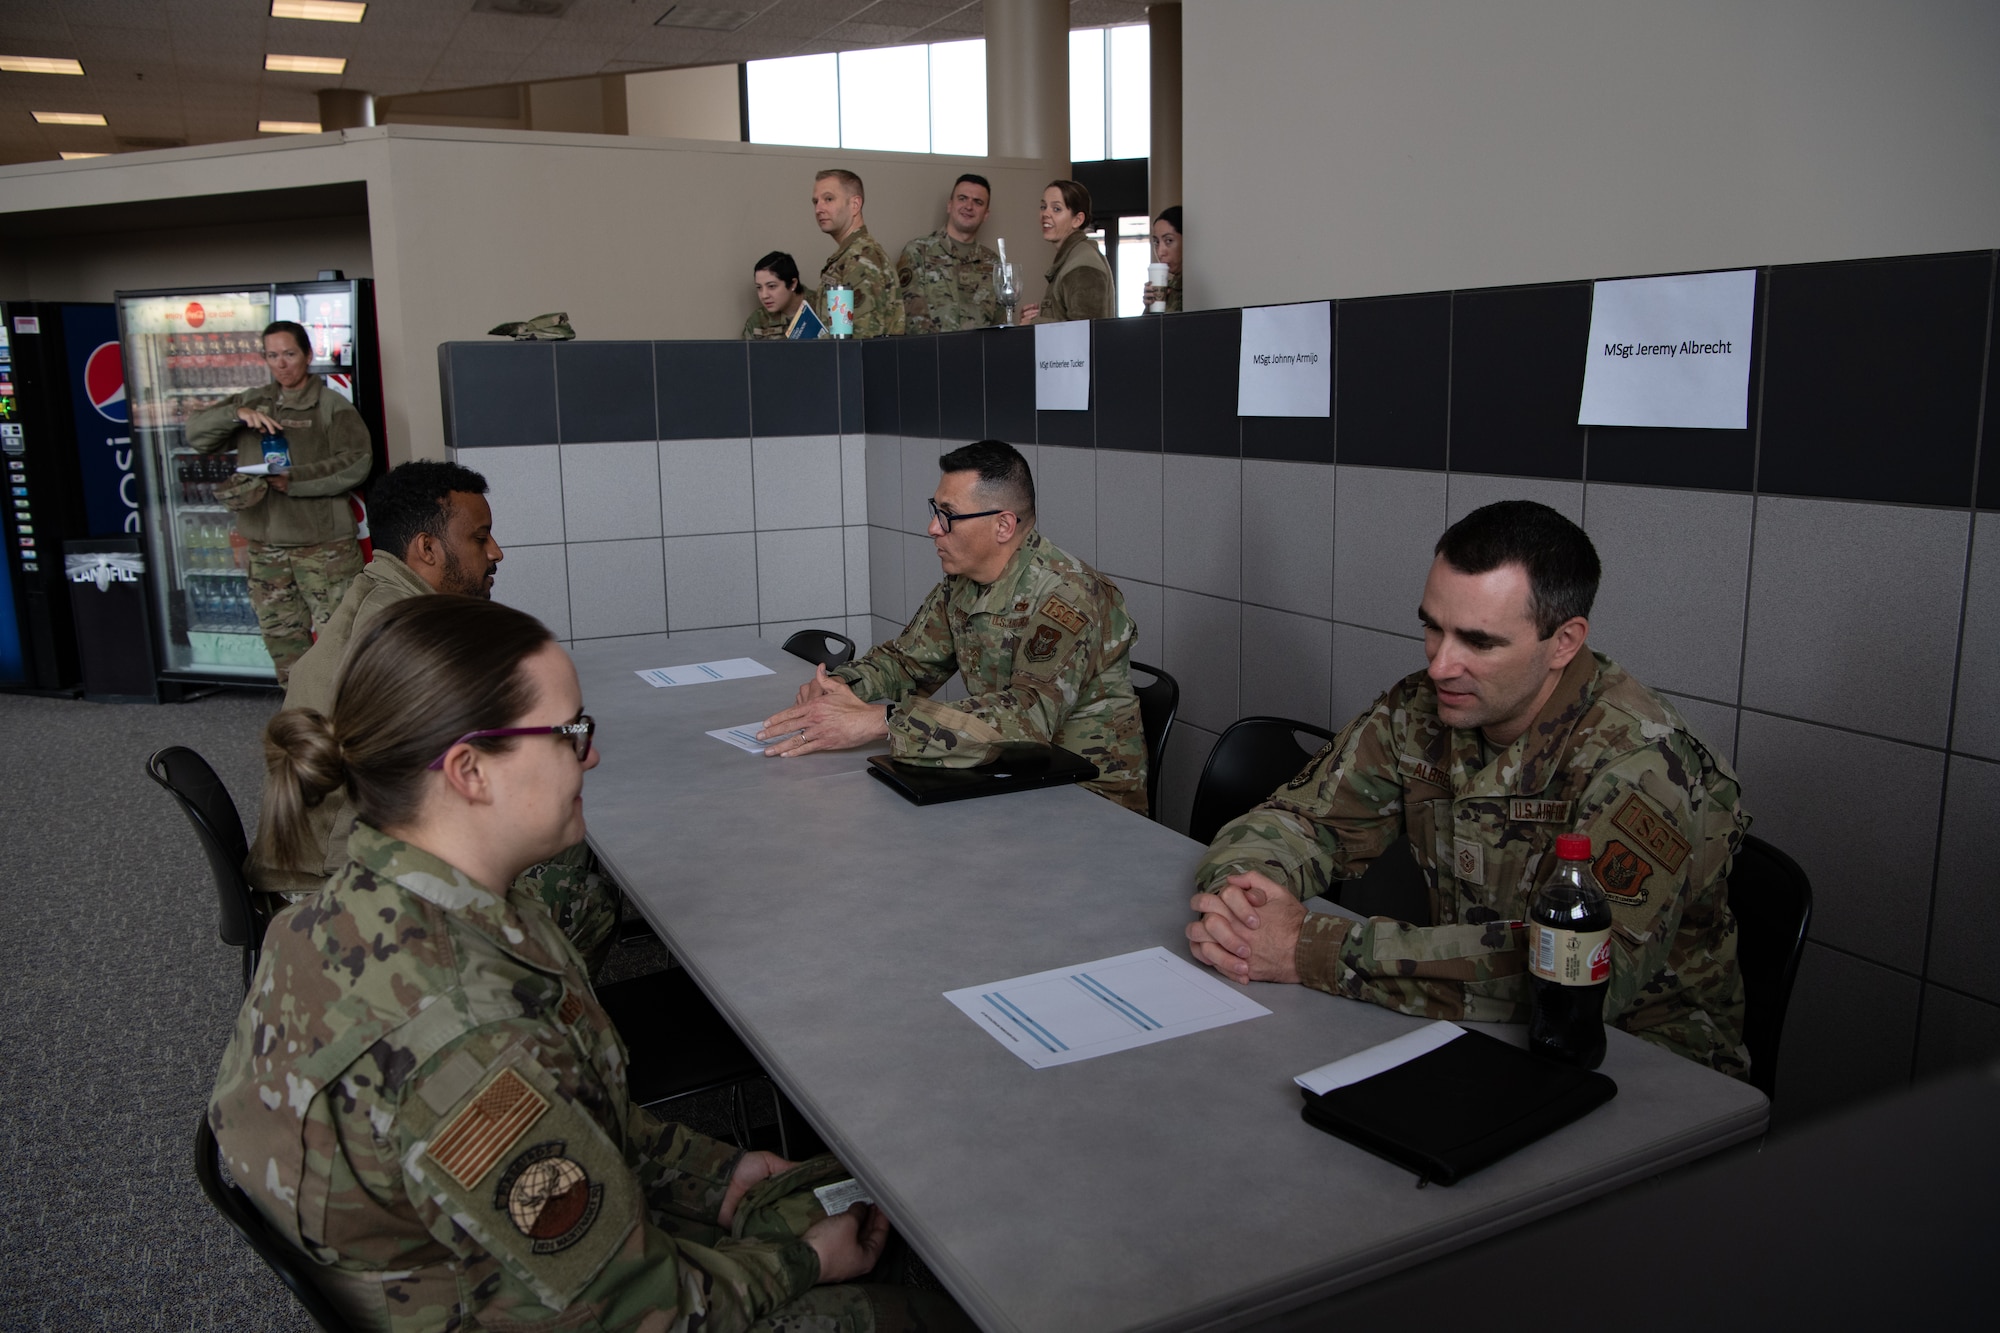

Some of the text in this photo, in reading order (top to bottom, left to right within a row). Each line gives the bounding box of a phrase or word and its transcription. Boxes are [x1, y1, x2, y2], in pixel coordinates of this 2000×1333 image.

[1604, 339, 1732, 359] MSgt Jeremy Albrecht
[1039, 358, 1085, 370] MSgt Kimberlee Tucker
[1253, 352, 1318, 366] MSgt Johnny Armijo
[1045, 601, 1085, 630] 1SGT
[1514, 801, 1535, 819] U.S.
[1625, 805, 1686, 862] 1SGT
